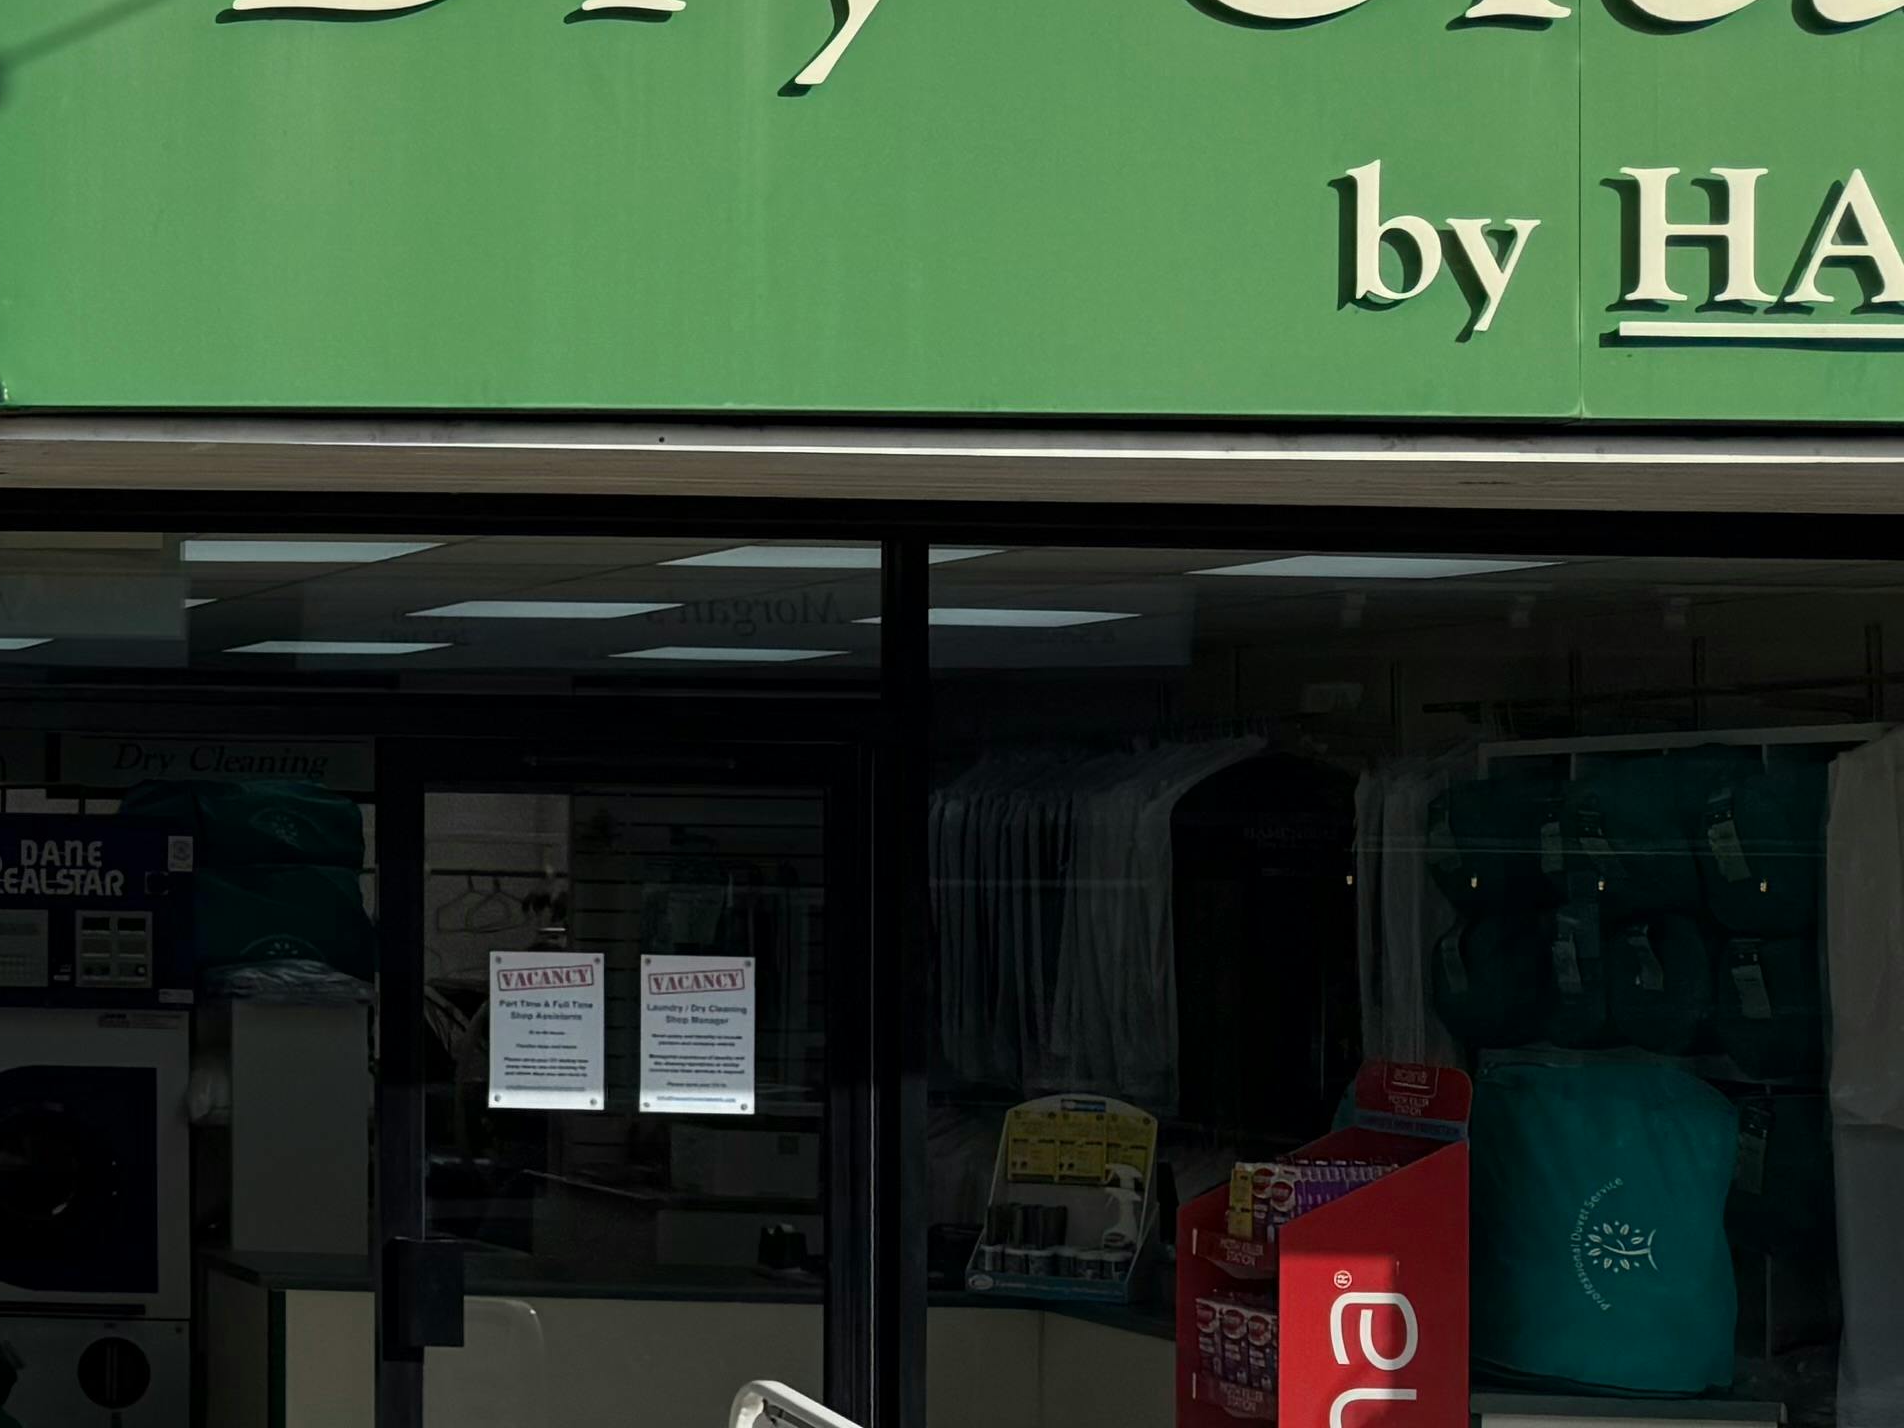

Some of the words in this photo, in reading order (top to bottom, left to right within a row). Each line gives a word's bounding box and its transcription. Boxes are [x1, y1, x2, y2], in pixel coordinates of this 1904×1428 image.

[1349, 159, 1541, 332] by
[113, 743, 178, 773] Dry
[190, 745, 329, 778] Cleaning
[502, 968, 589, 989] VACANCY
[653, 972, 739, 993] VACANCY
[647, 1004, 683, 1014] Laundry
[708, 1005, 747, 1015] Cleaning
[1584, 1177, 1623, 1210] Service
[1570, 1207, 1591, 1242] Duvet
[1571, 1243, 1613, 1311] Professional
